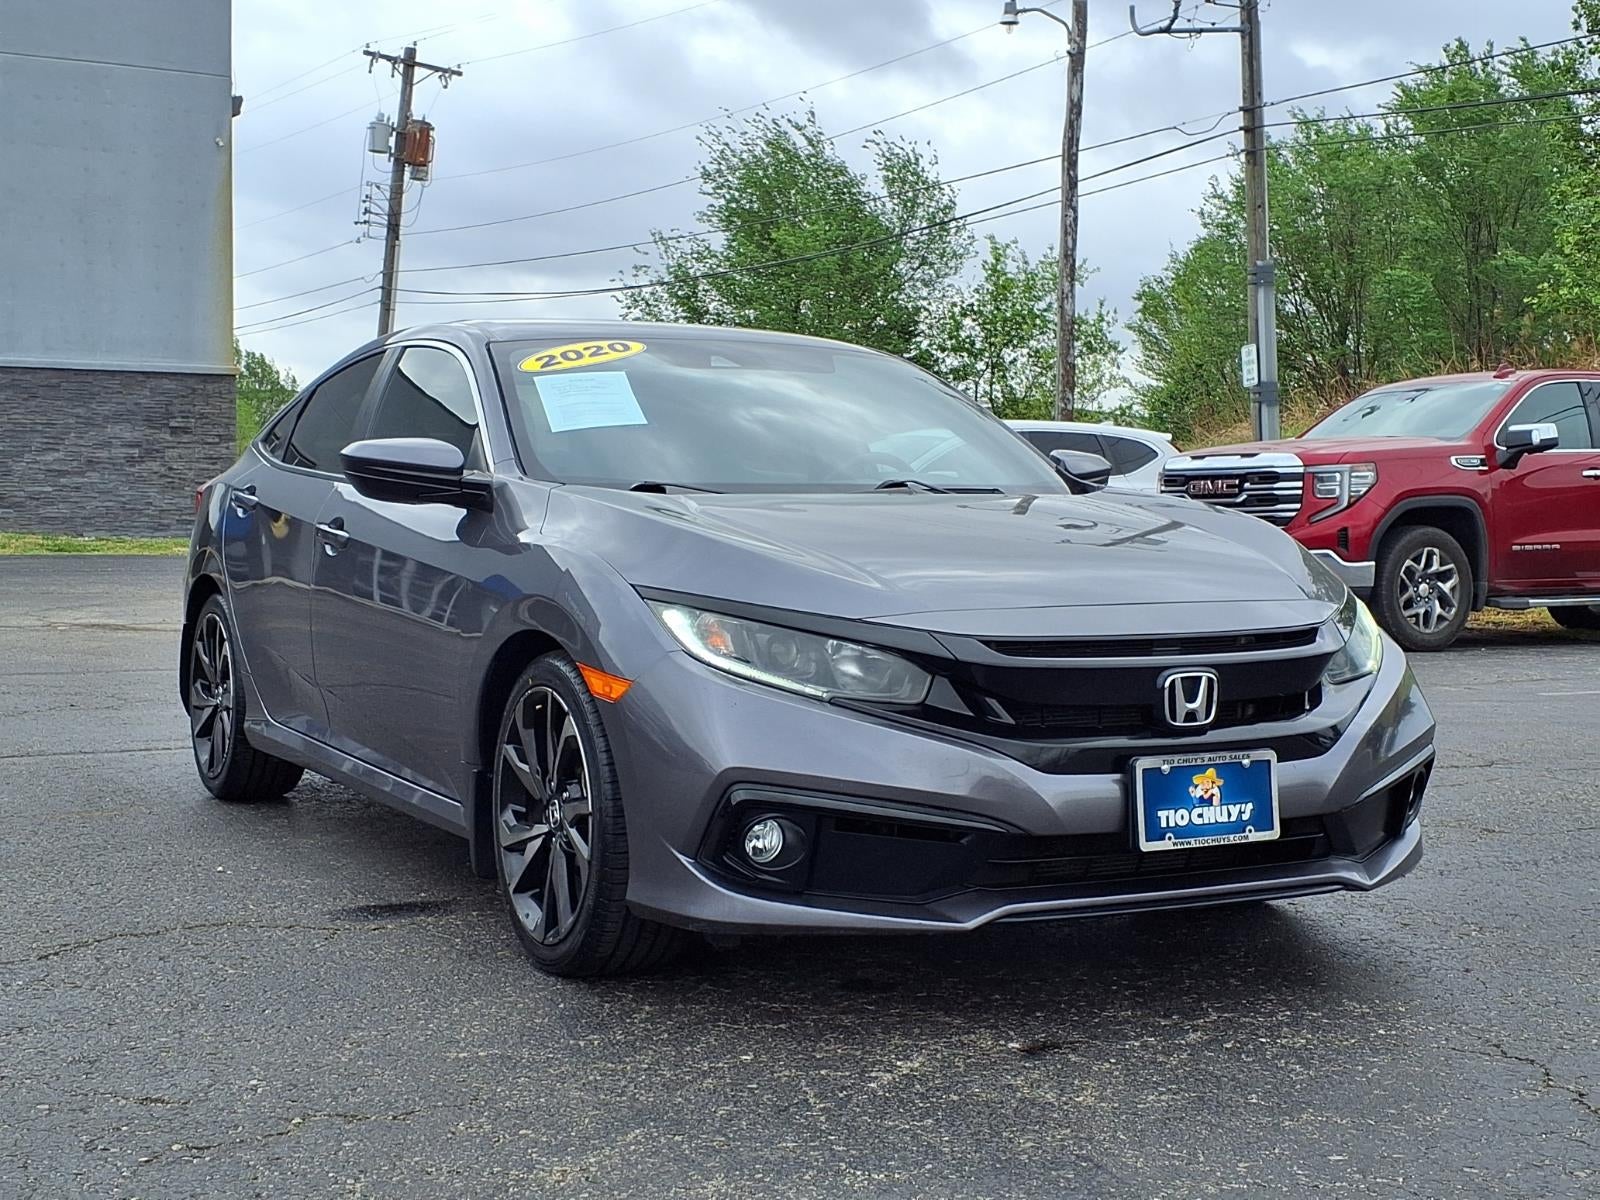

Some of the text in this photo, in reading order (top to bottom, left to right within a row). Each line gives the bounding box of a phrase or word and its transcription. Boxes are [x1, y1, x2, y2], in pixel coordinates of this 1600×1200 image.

[535, 342, 630, 369] 2020
[1188, 479, 1239, 494] GMC
[1177, 756, 1205, 765] CHUY'S
[1228, 753, 1250, 761] SALES
[1172, 834, 1249, 848] WWW.TIOCHUYS.COM
